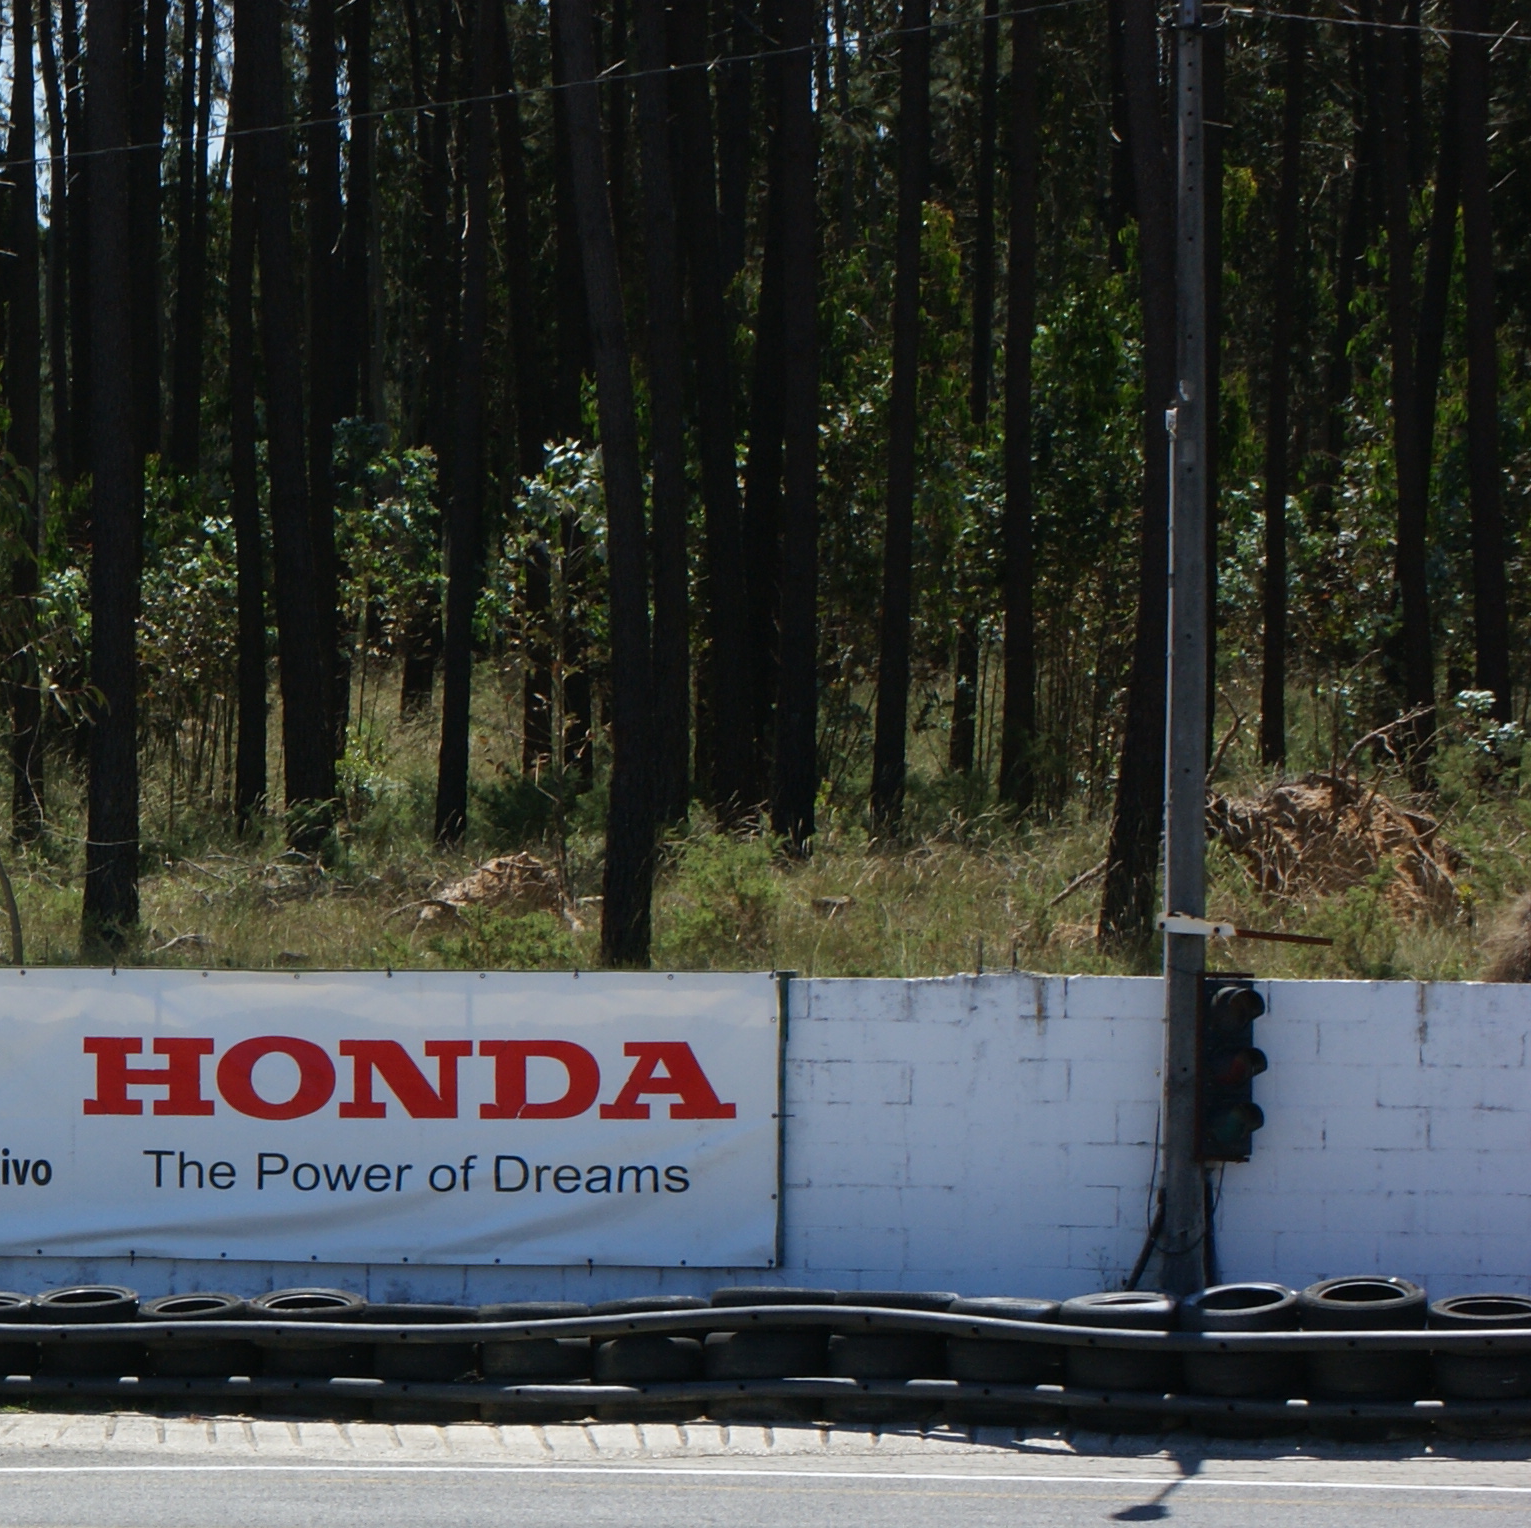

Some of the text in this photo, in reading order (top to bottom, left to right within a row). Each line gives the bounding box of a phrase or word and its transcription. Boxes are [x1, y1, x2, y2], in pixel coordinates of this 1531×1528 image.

[83, 1036, 737, 1120] HONDA
[142, 1149, 691, 1194] The Power of Dreams
